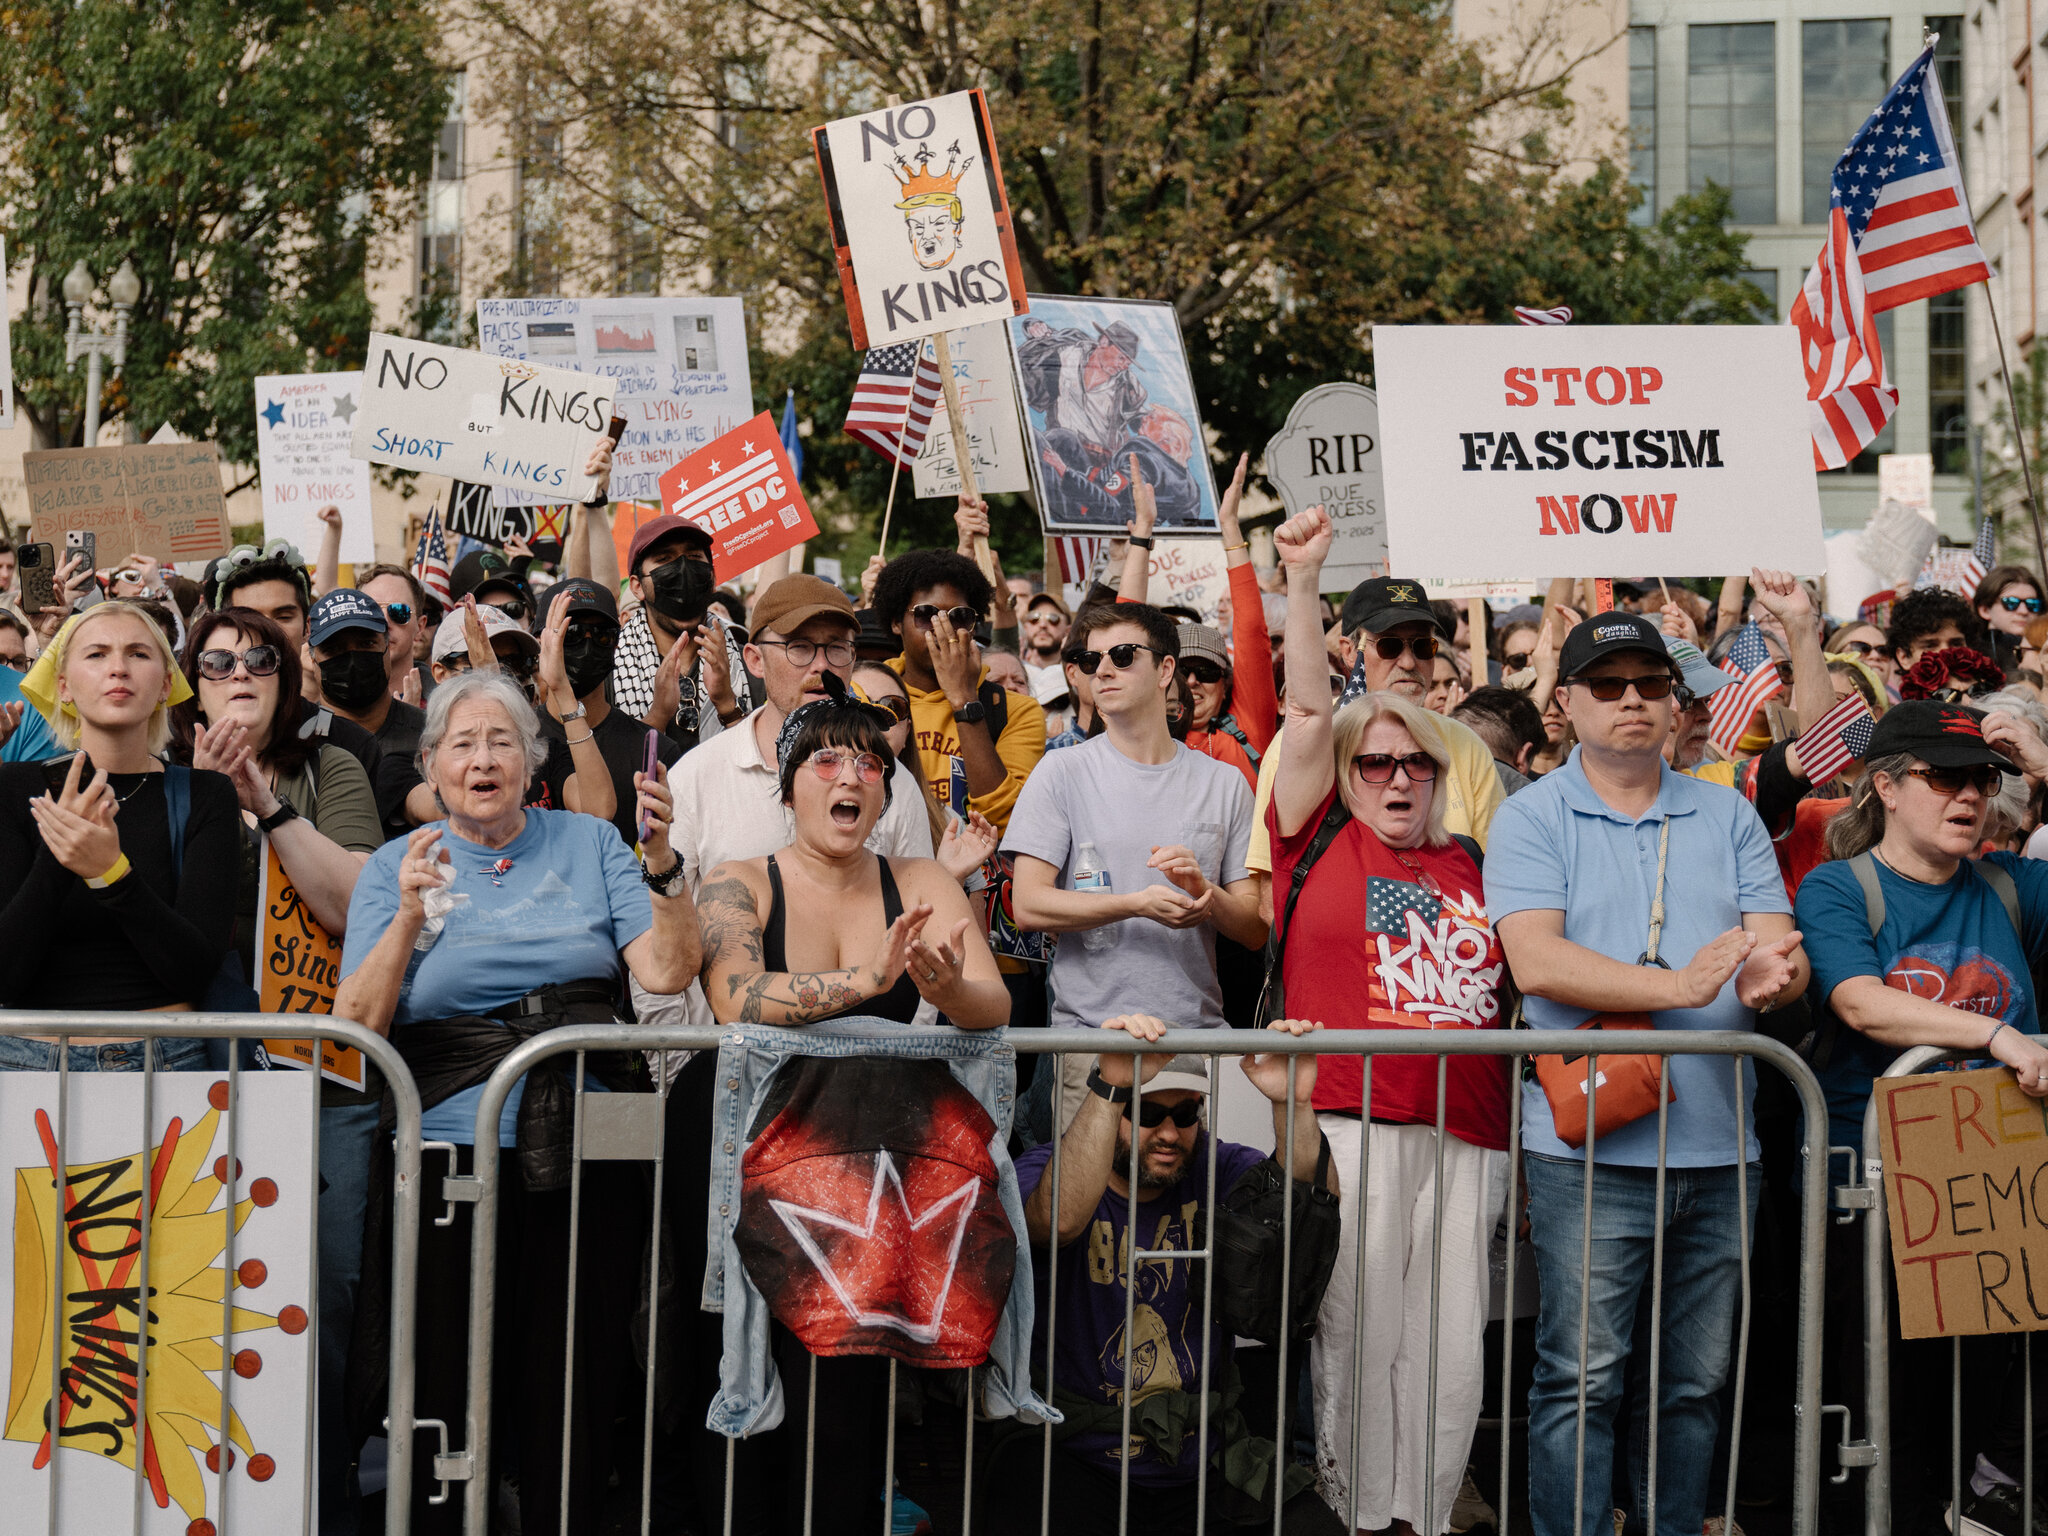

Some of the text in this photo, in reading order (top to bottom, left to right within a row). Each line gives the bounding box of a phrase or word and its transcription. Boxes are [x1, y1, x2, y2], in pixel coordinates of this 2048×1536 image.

[860, 105, 936, 163] NO
[881, 260, 1009, 332] KINGS
[483, 321, 522, 342] FACTS
[498, 344, 515, 352] ON
[606, 364, 655, 377] DOWN IN
[679, 373, 726, 382] DOWN IN
[377, 348, 610, 433] NO KINGS
[684, 385, 729, 395] PORTLAND
[1503, 365, 1663, 407] STOP
[291, 411, 328, 428] IDEA
[642, 400, 693, 422] LYING
[467, 422, 493, 434] BUT
[655, 429, 681, 443] WAS
[685, 426, 706, 442] HIS
[372, 427, 567, 486] SHORT KINGS
[615, 451, 636, 466] THE
[640, 448, 673, 465] ENEMY
[1308, 433, 1374, 476] RIP
[1459, 428, 1725, 471] FASCISM
[33, 483, 104, 513] MAKE
[113, 471, 219, 498] AMERICA
[275, 482, 355, 504] NO KINGS
[691, 475, 787, 535] REE DC
[1319, 483, 1364, 502] DUE
[1535, 493, 1678, 536] NOW
[722, 518, 774, 550] FreeDCproject.org
[726, 529, 769, 556] @FreeDCproject
[1349, 526, 1375, 538] 2025
[1148, 547, 1185, 577] DUE
[318, 594, 367, 616] ARUBA
[1167, 585, 1206, 606] STOP
[329, 610, 350, 620] HAPPY
[1404, 909, 1488, 971] NO
[269, 932, 339, 989] Sinc
[1374, 933, 1503, 1024] KINGS
[1887, 1080, 2048, 1167] FRE
[52, 1158, 152, 1261] NO
[43, 1286, 159, 1457] KINGS
